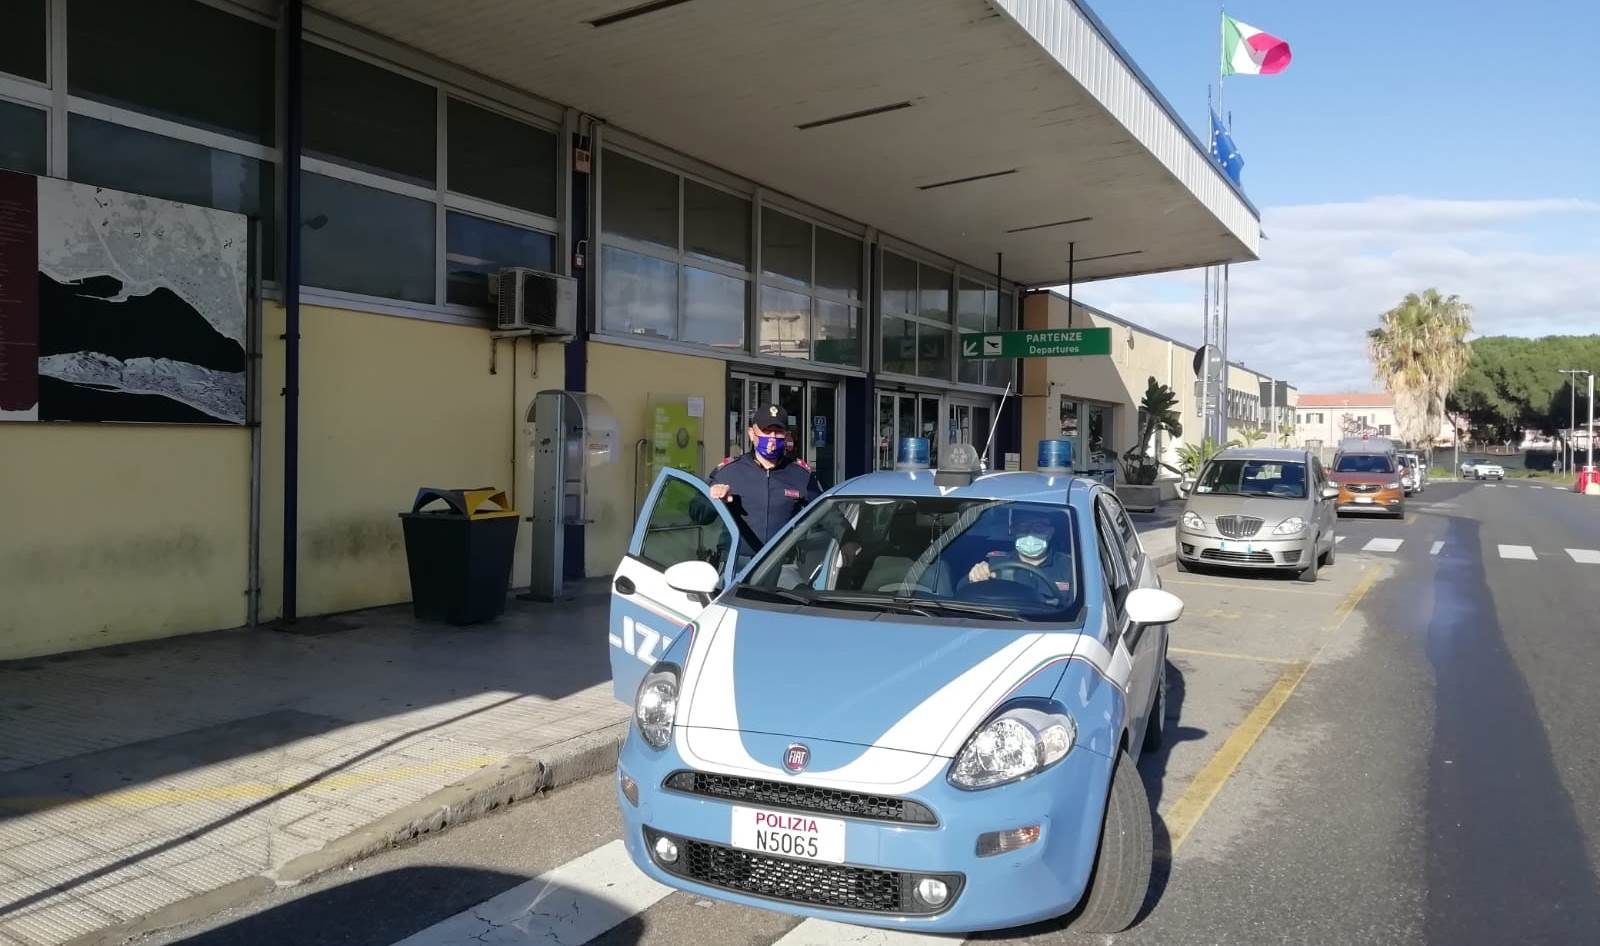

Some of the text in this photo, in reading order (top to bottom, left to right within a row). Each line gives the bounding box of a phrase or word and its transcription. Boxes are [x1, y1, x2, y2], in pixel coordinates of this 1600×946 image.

[1026, 332, 1083, 343] PARTENZE
[1029, 345, 1080, 356] Departures
[788, 750, 807, 764] FIAT
[756, 812, 818, 833] POLIZIA
[756, 829, 818, 858] N5065
